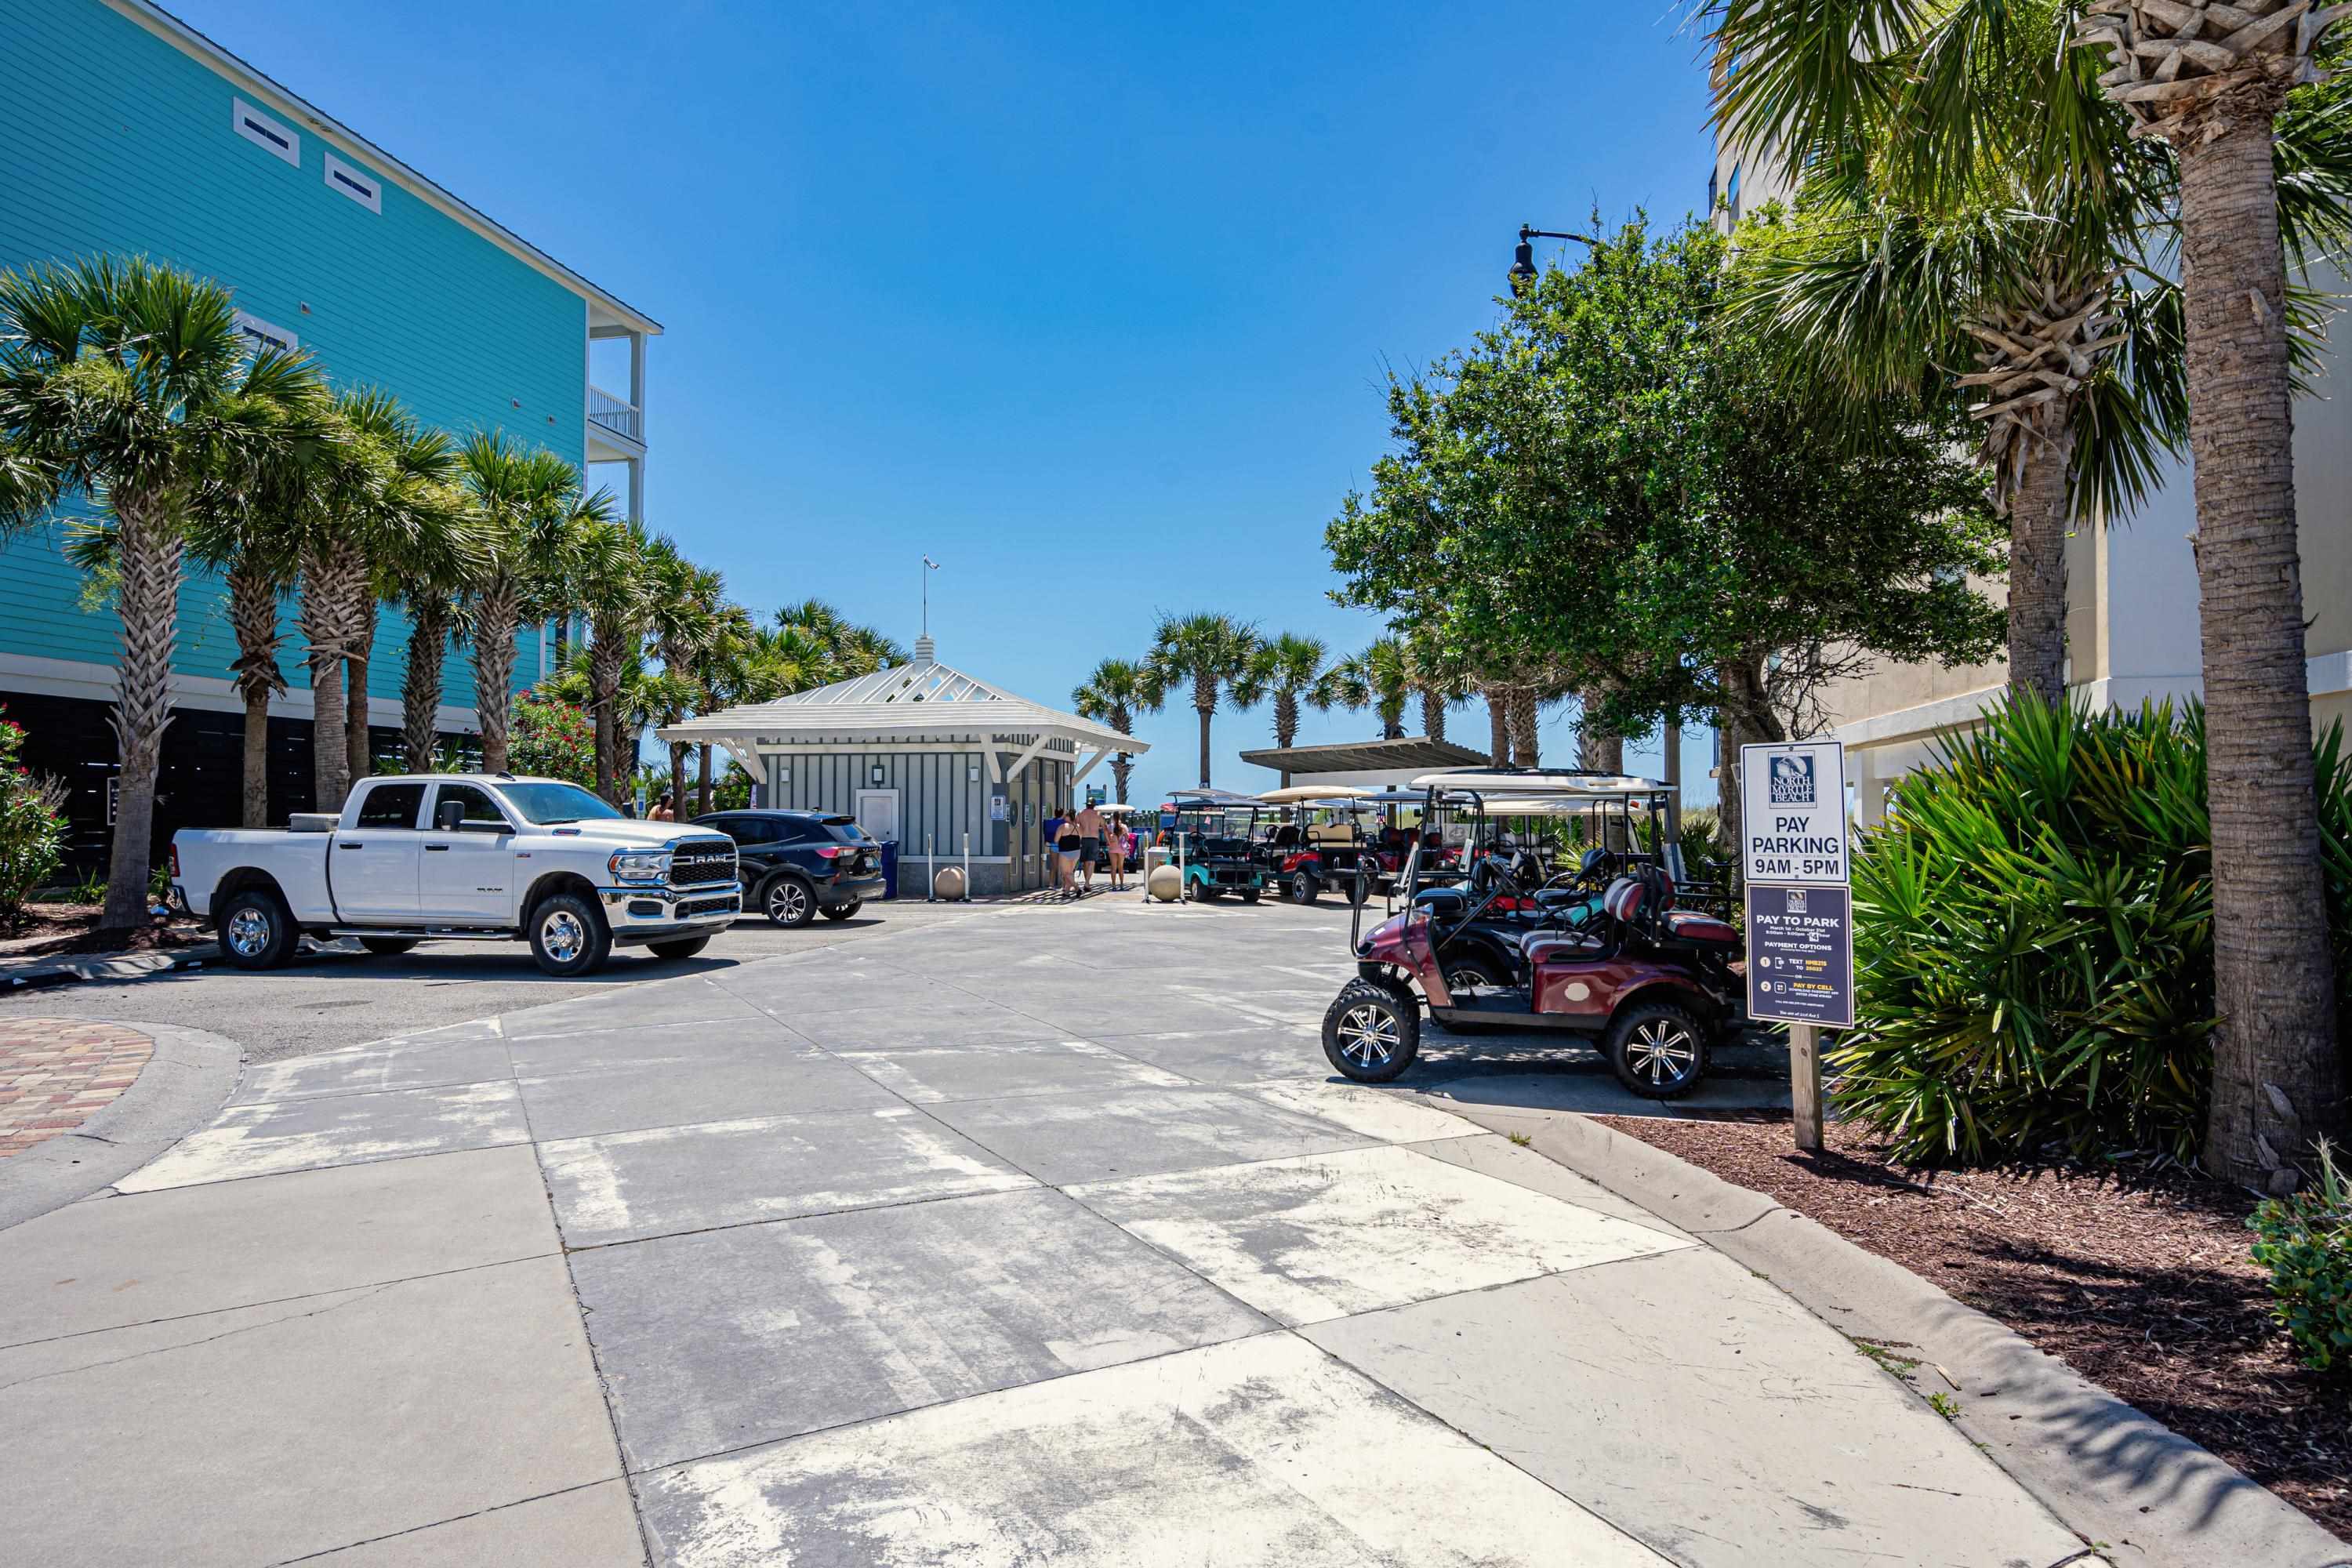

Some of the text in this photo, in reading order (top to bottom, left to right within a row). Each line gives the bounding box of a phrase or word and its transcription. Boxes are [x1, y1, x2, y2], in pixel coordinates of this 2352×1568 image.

[1773, 776, 1810, 786] NORTH
[1772, 785, 1813, 794] MYRTLE
[1775, 793, 1809, 802] BEACH
[1776, 817, 1809, 833] PAY
[1752, 837, 1838, 854] PARKING
[696, 855, 724, 863] RAM
[1755, 859, 1791, 873] 9AM
[1803, 859, 1838, 875] 5PM
[1756, 914, 1839, 927] PAY TO PARK
